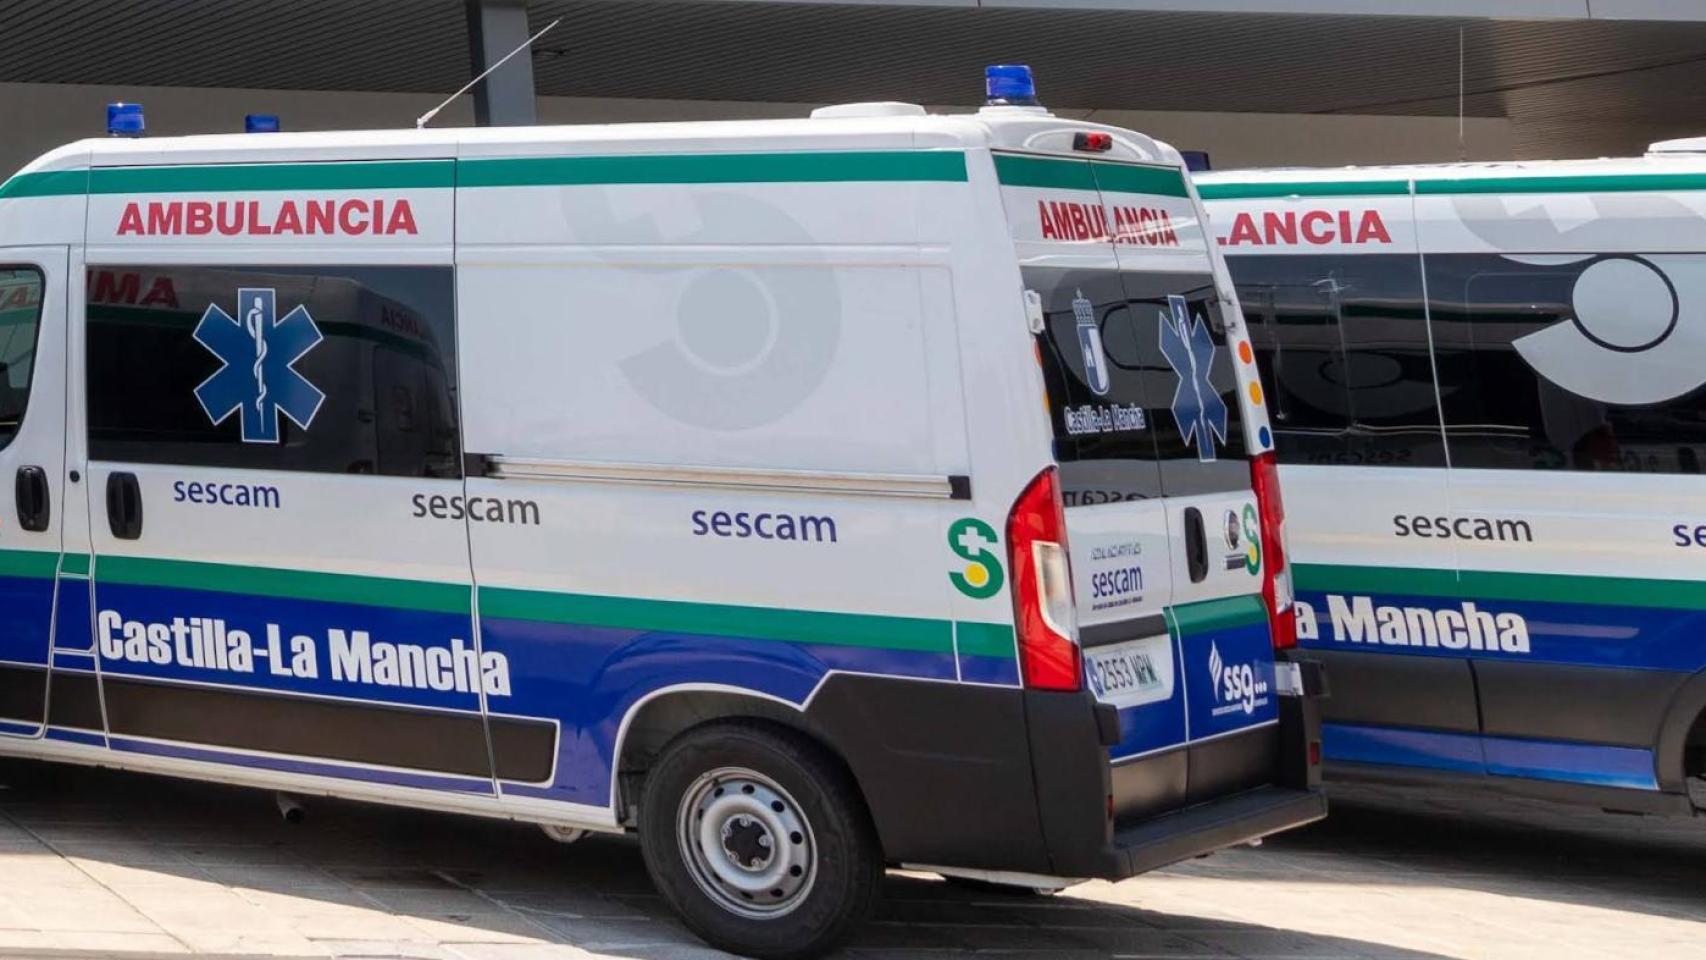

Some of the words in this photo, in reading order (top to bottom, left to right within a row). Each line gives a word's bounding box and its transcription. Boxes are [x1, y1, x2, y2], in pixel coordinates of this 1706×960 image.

[116, 198, 418, 236] AMBULANCIA
[1037, 200, 1180, 247] AMBULANCIA
[1217, 209, 1392, 246] ANCIA
[173, 479, 281, 510] sescam
[411, 491, 542, 526] sescam
[691, 509, 838, 543] sescam
[1394, 513, 1534, 543] sescam
[1091, 566, 1143, 599] sescam
[1326, 594, 1531, 653] Mancha
[327, 628, 512, 697] Mancha
